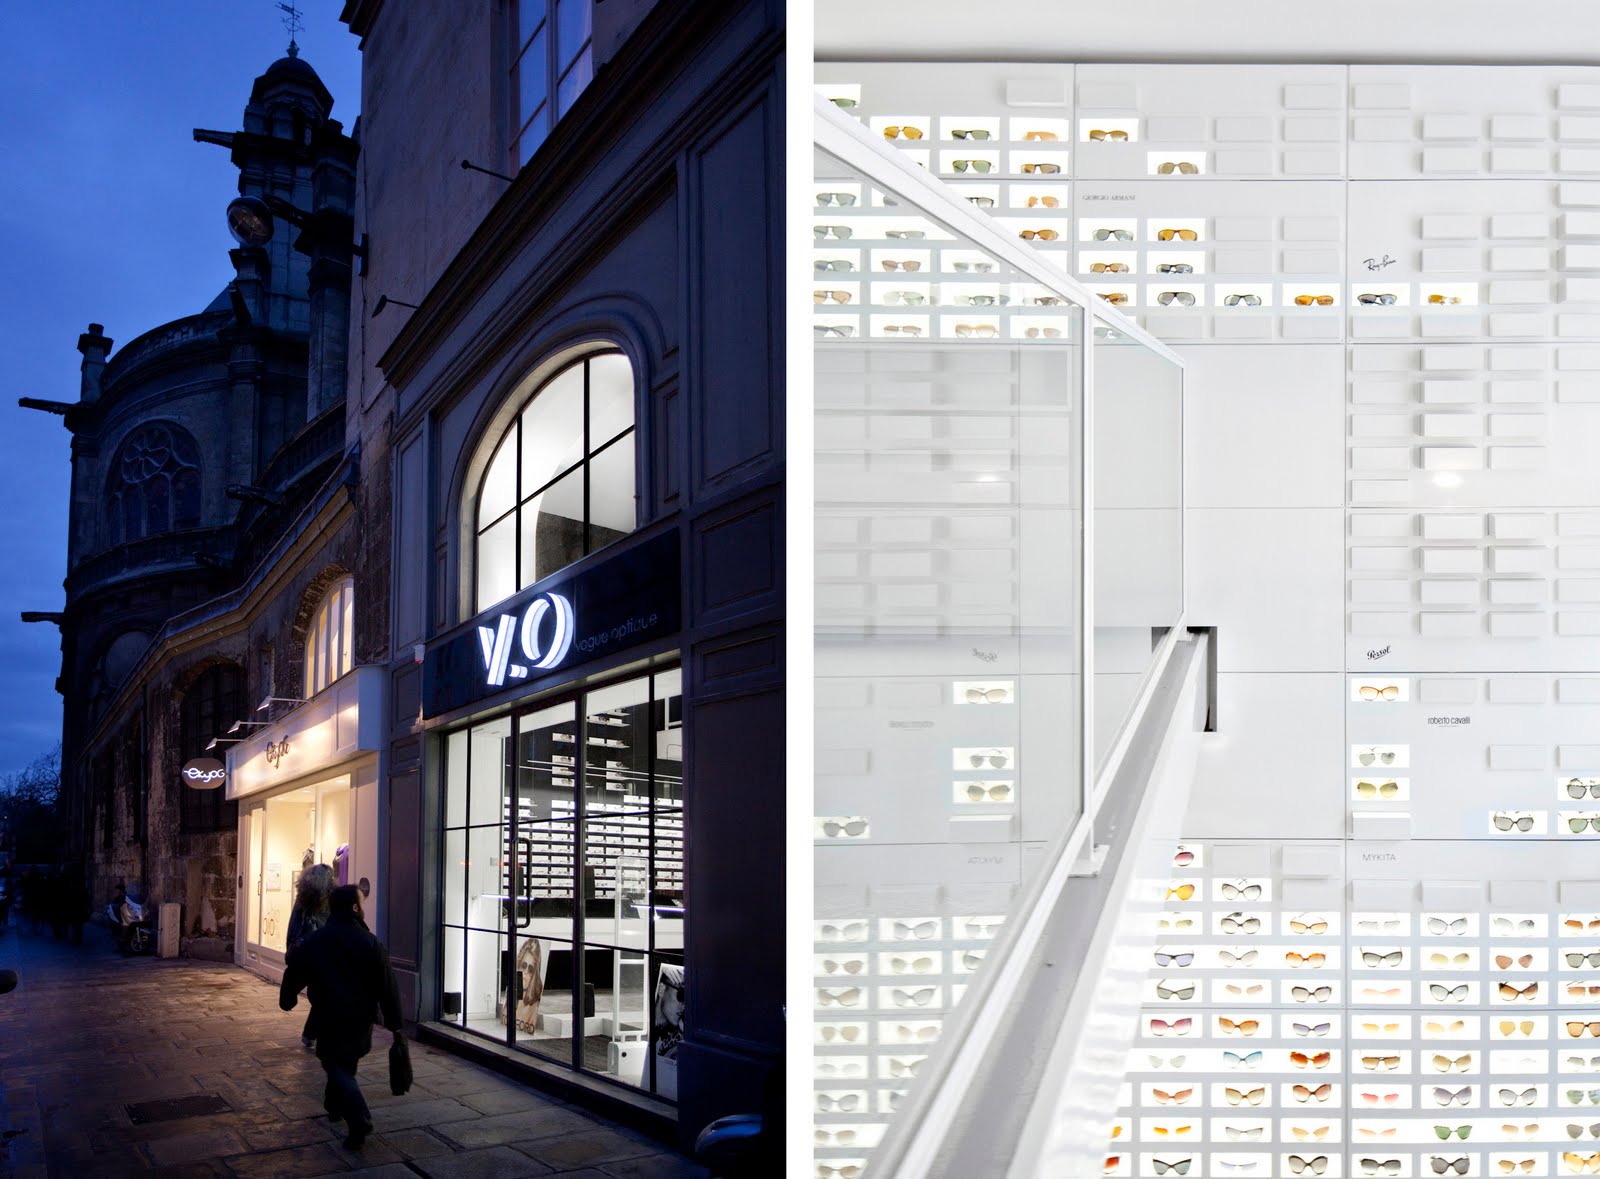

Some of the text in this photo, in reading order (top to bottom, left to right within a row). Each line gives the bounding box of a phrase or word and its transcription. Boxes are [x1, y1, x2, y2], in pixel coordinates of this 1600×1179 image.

[575, 613, 657, 652] vogue optique
[1366, 645, 1391, 661] Persol
[1427, 716, 1471, 725] roberto cavalli
[1362, 853, 1396, 862] MYKITA
